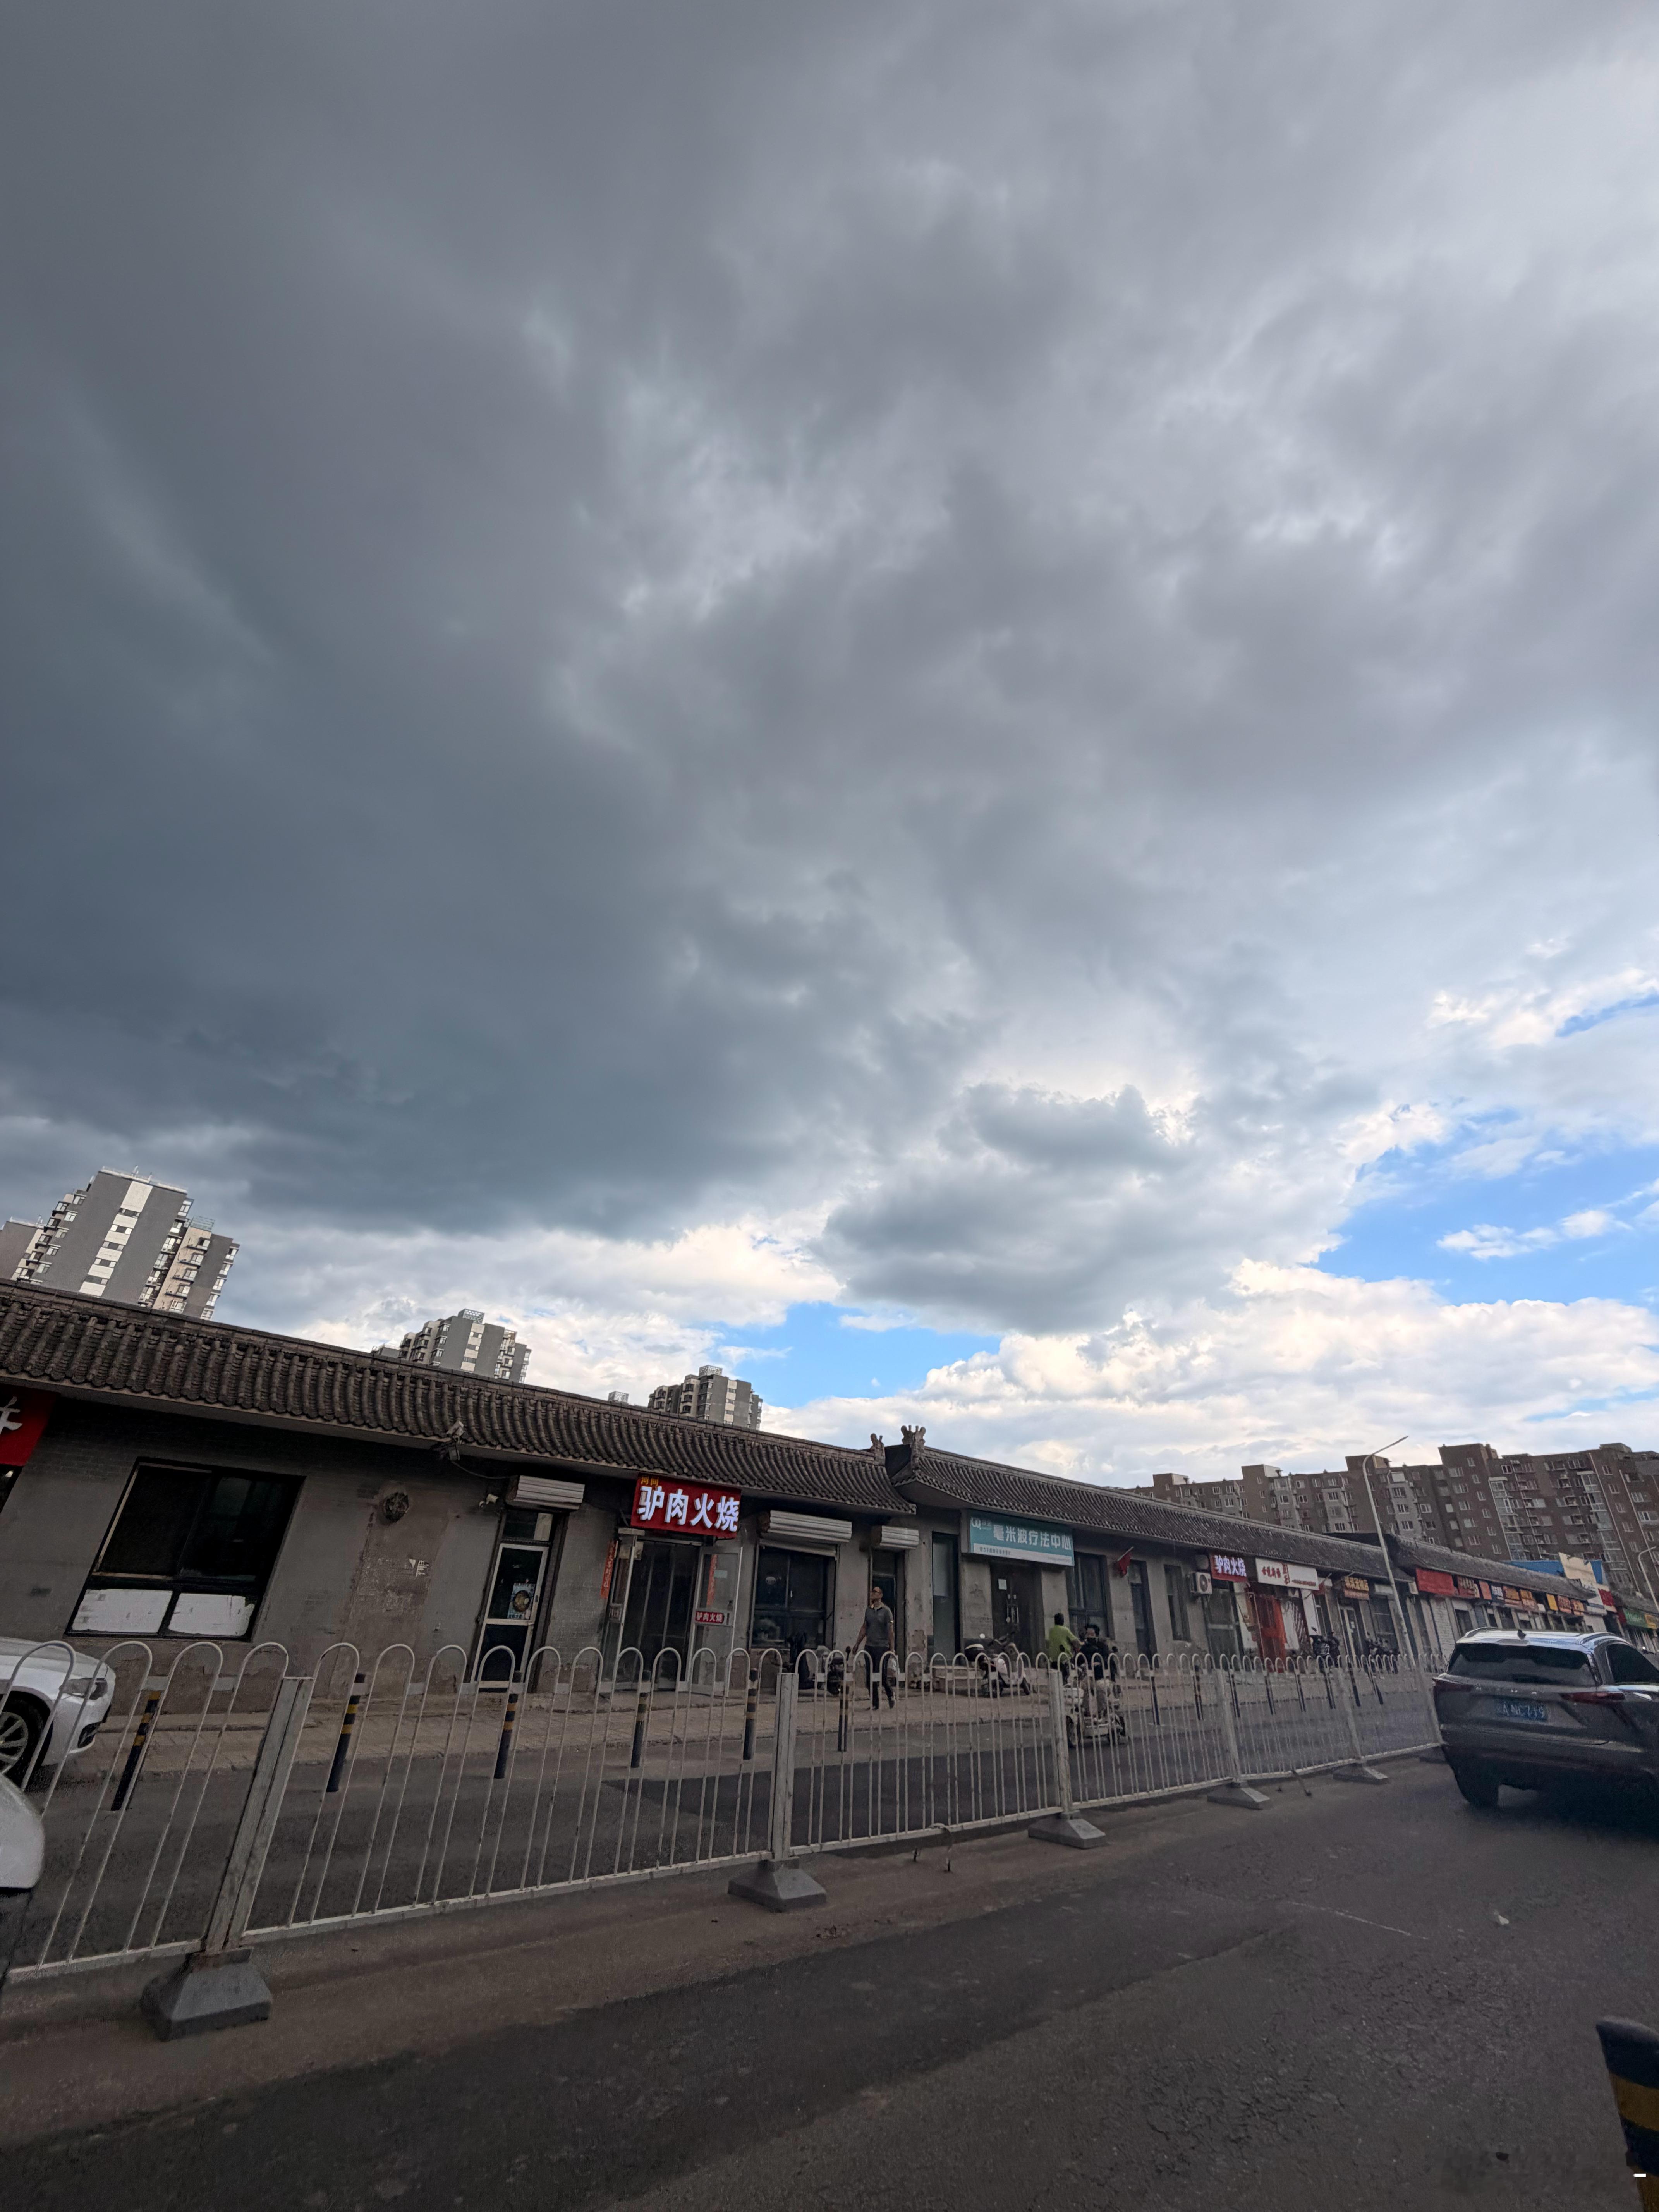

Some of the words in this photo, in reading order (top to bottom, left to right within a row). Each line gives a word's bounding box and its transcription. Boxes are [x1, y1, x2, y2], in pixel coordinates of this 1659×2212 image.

[637, 1486, 740, 1532] 驴肉火烧
[1214, 1554, 1247, 1577] 驴肉火烧
[696, 1612, 723, 1623] 驴肉火烧
